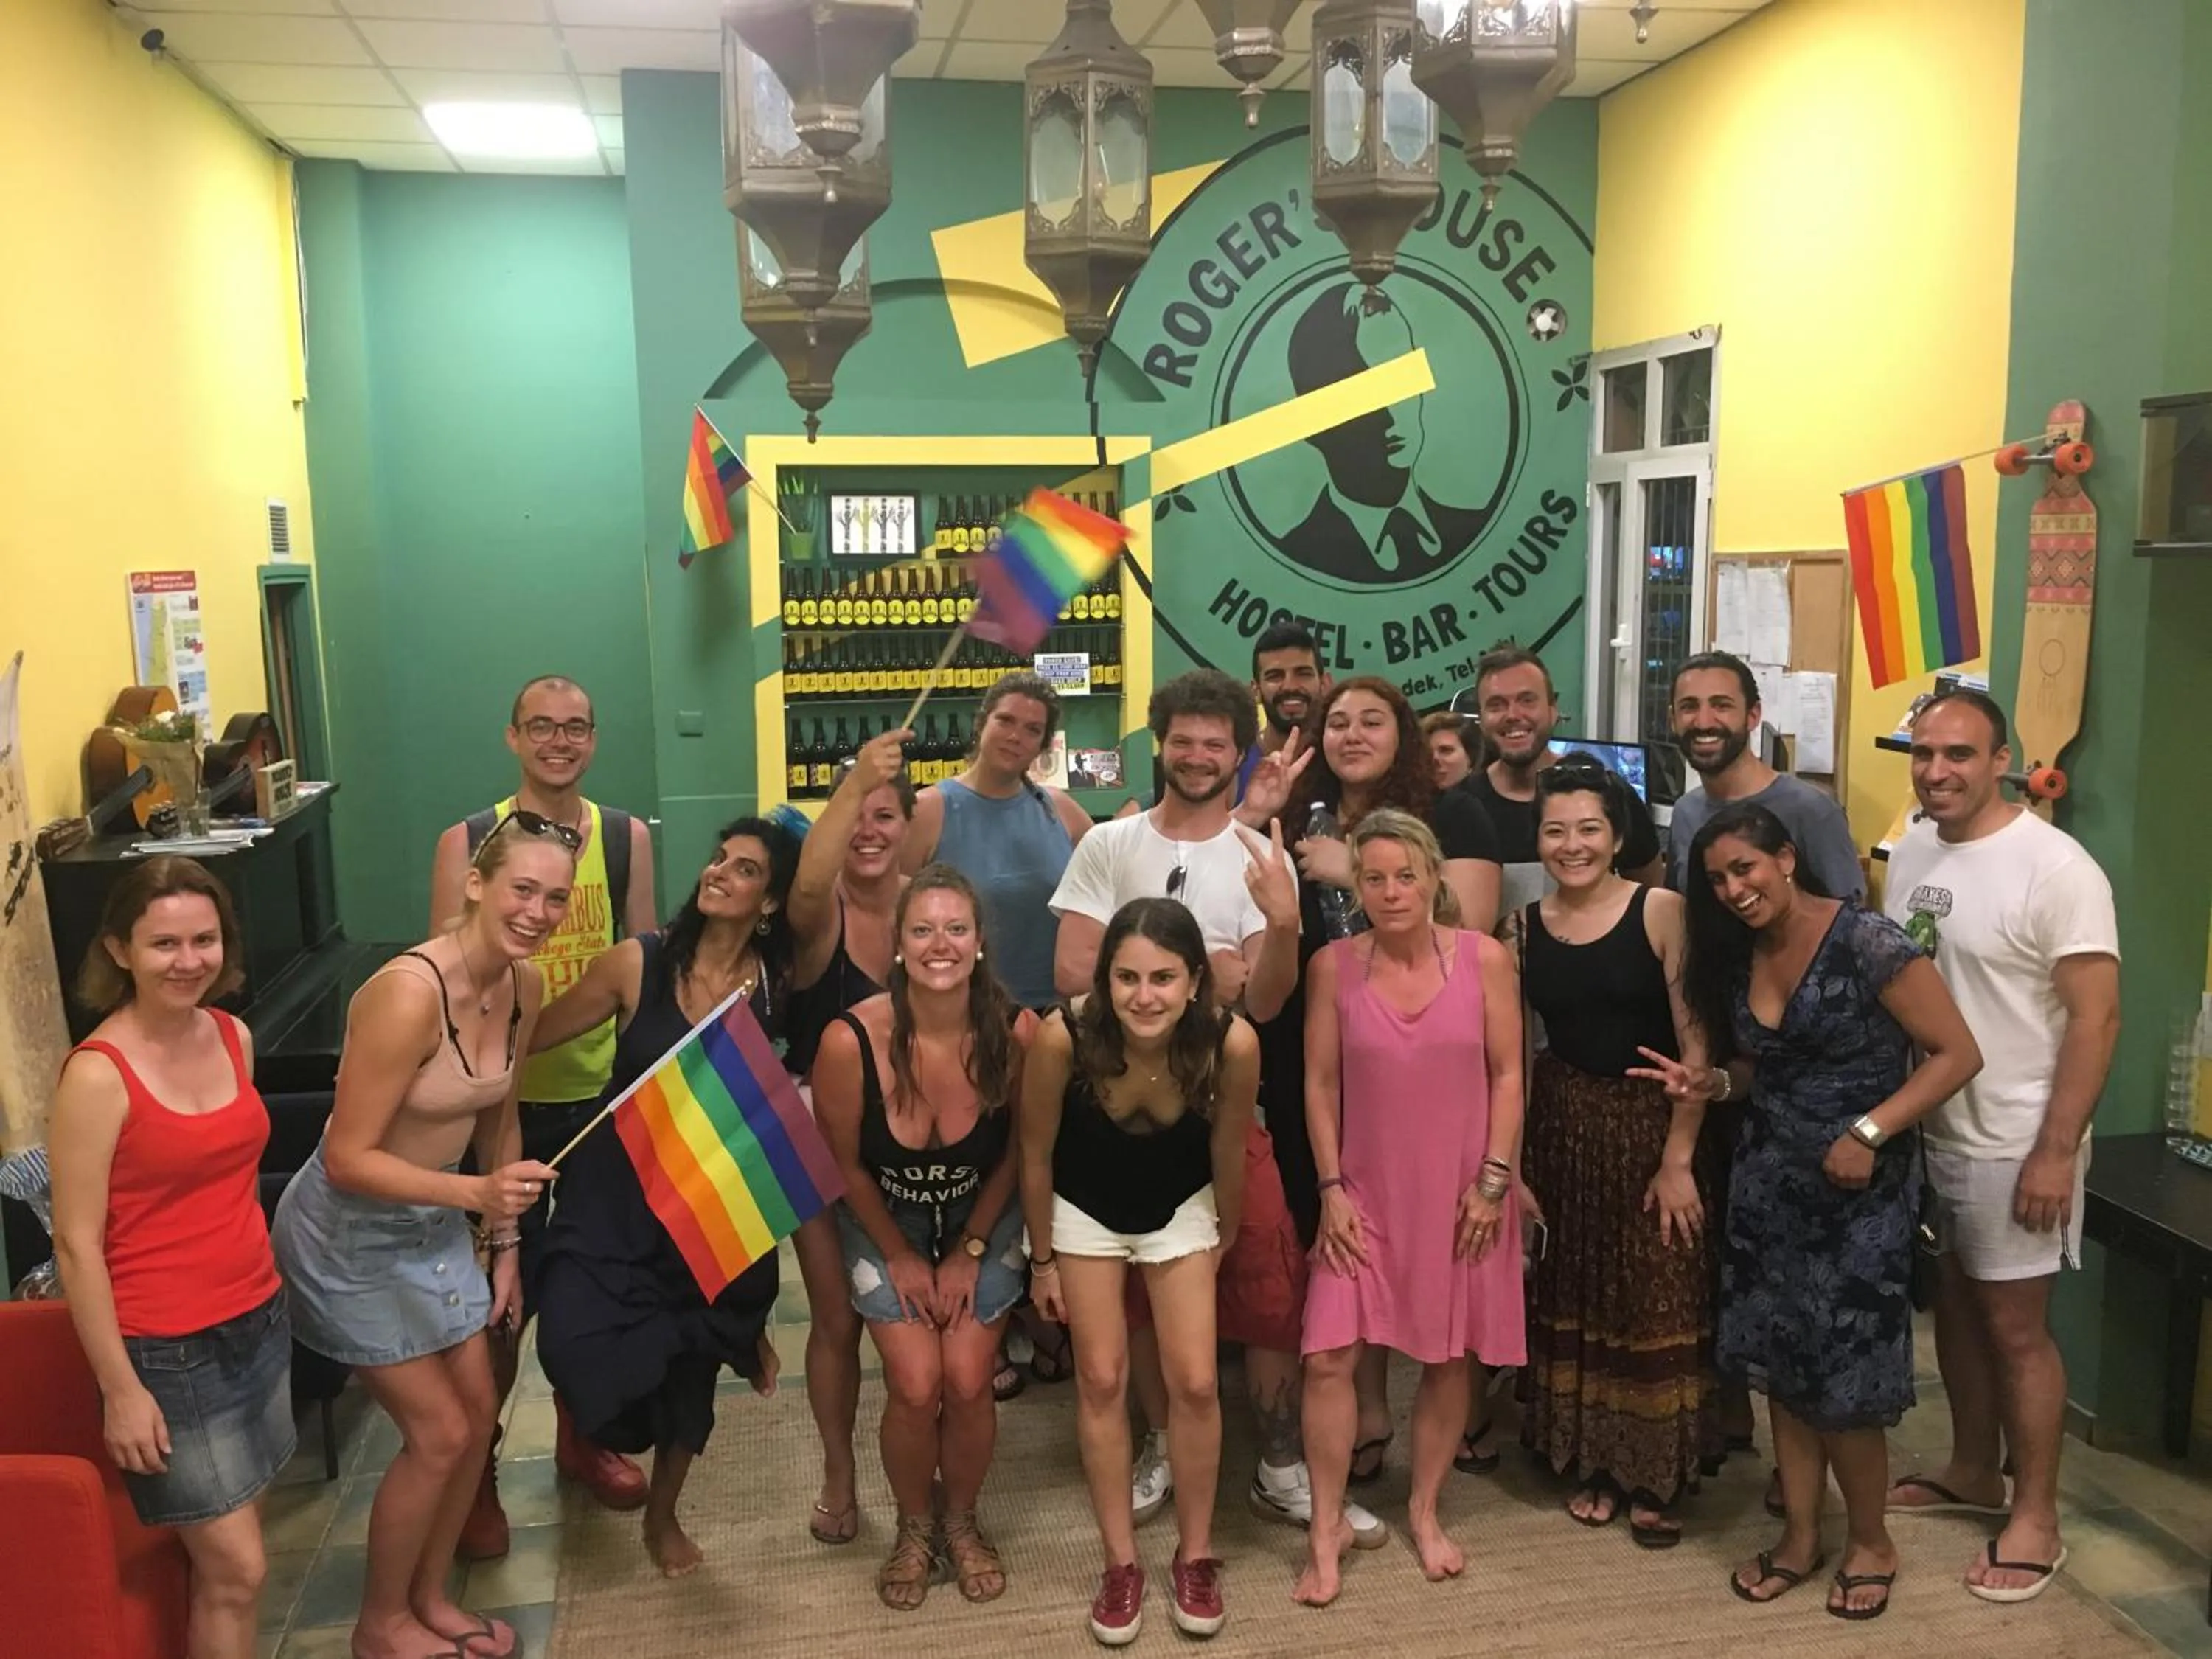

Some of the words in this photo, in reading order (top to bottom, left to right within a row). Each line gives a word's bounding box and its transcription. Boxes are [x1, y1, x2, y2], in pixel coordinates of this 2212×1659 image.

[1143, 188, 1333, 389] ROGER'
[1414, 181, 1556, 304] USE
[1382, 604, 1467, 664] BAR
[1472, 488, 1578, 613] TOURS
[1402, 673, 1444, 697] dek,
[1445, 656, 1476, 683] Tel
[880, 1164, 978, 1180] ORS
